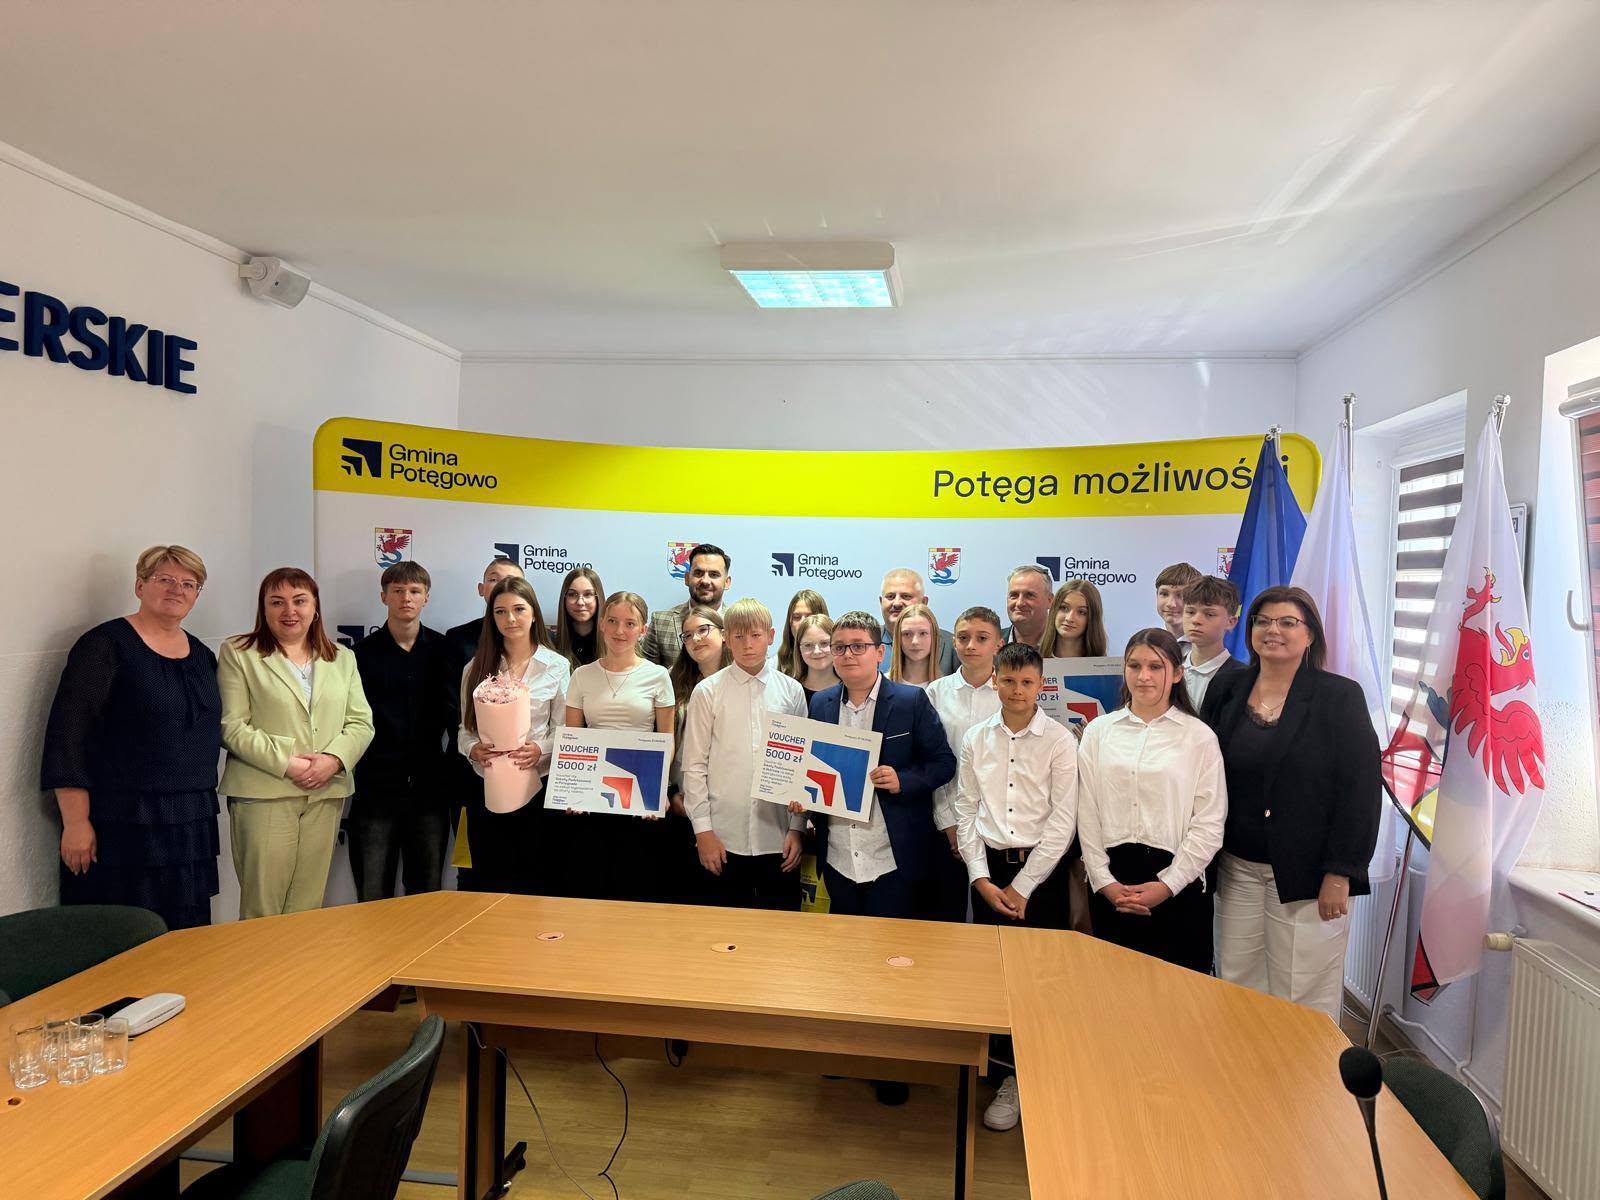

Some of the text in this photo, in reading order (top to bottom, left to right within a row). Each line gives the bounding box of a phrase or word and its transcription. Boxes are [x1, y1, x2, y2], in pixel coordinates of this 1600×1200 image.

[0, 281, 198, 394] ERSKIE
[389, 443, 458, 466] Gmina
[390, 463, 498, 489] Potęgowo
[934, 454, 1289, 504] Potęga możliwośi
[523, 544, 568, 558] Gmina
[524, 557, 593, 574] Potęgowo
[798, 553, 839, 565] Gmina
[1064, 556, 1110, 569] Gmina
[799, 566, 863, 580] Potęgowo
[1065, 570, 1137, 585] Potęgowo
[769, 731, 806, 745] VOUCHER
[560, 744, 600, 754] VOUCHER
[765, 748, 803, 763] 5000 zł
[557, 760, 597, 772] 5000 zł
